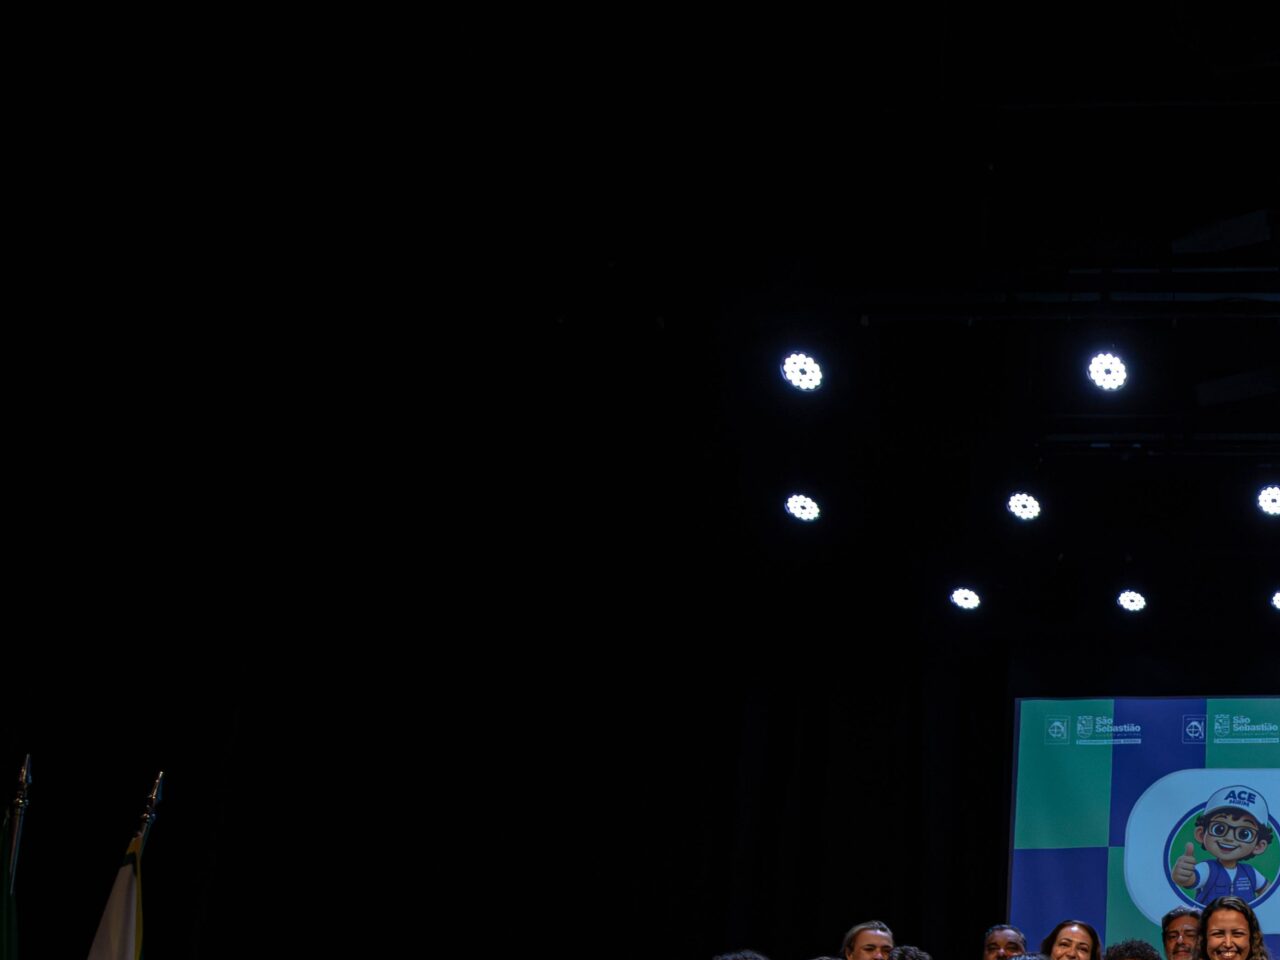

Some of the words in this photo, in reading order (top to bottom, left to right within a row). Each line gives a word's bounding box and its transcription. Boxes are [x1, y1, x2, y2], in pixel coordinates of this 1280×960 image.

[1096, 716, 1113, 724] São
[1233, 715, 1250, 724] São
[1095, 723, 1141, 733] Sebastião
[1232, 723, 1278, 732] Sebastião
[1224, 790, 1256, 804] ACE
